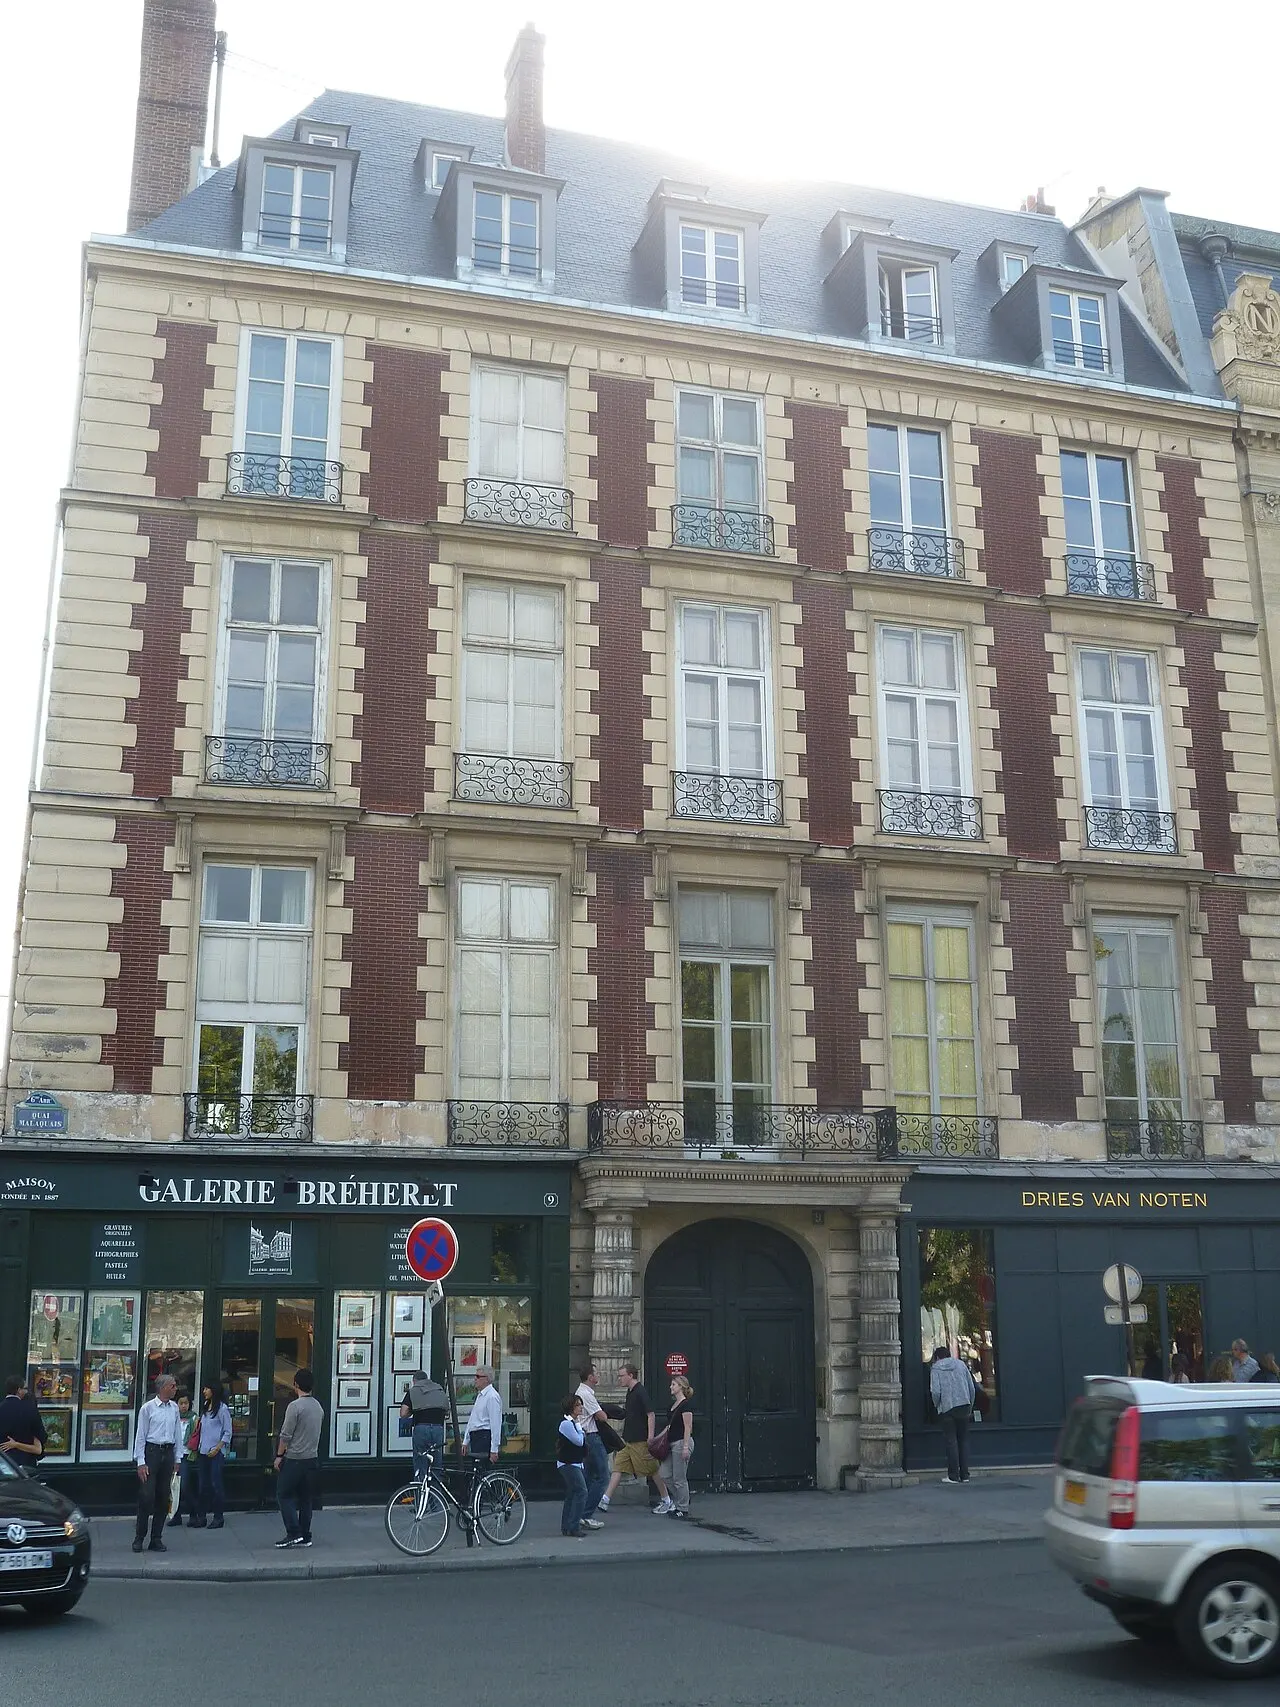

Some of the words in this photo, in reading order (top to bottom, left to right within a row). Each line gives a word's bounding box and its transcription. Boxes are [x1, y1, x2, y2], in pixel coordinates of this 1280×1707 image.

[32, 1112, 50, 1120] QUAI
[19, 1119, 63, 1128] MALAQUAIS
[5, 1177, 56, 1191] MAISON
[139, 1178, 276, 1204] GALERIE
[297, 1174, 458, 1207] BRÉHERET
[547, 1195, 555, 1206] 9
[1022, 1191, 1084, 1207] DRIES
[1092, 1192, 1130, 1207] VAN
[1140, 1192, 1207, 1207] NOTEN
